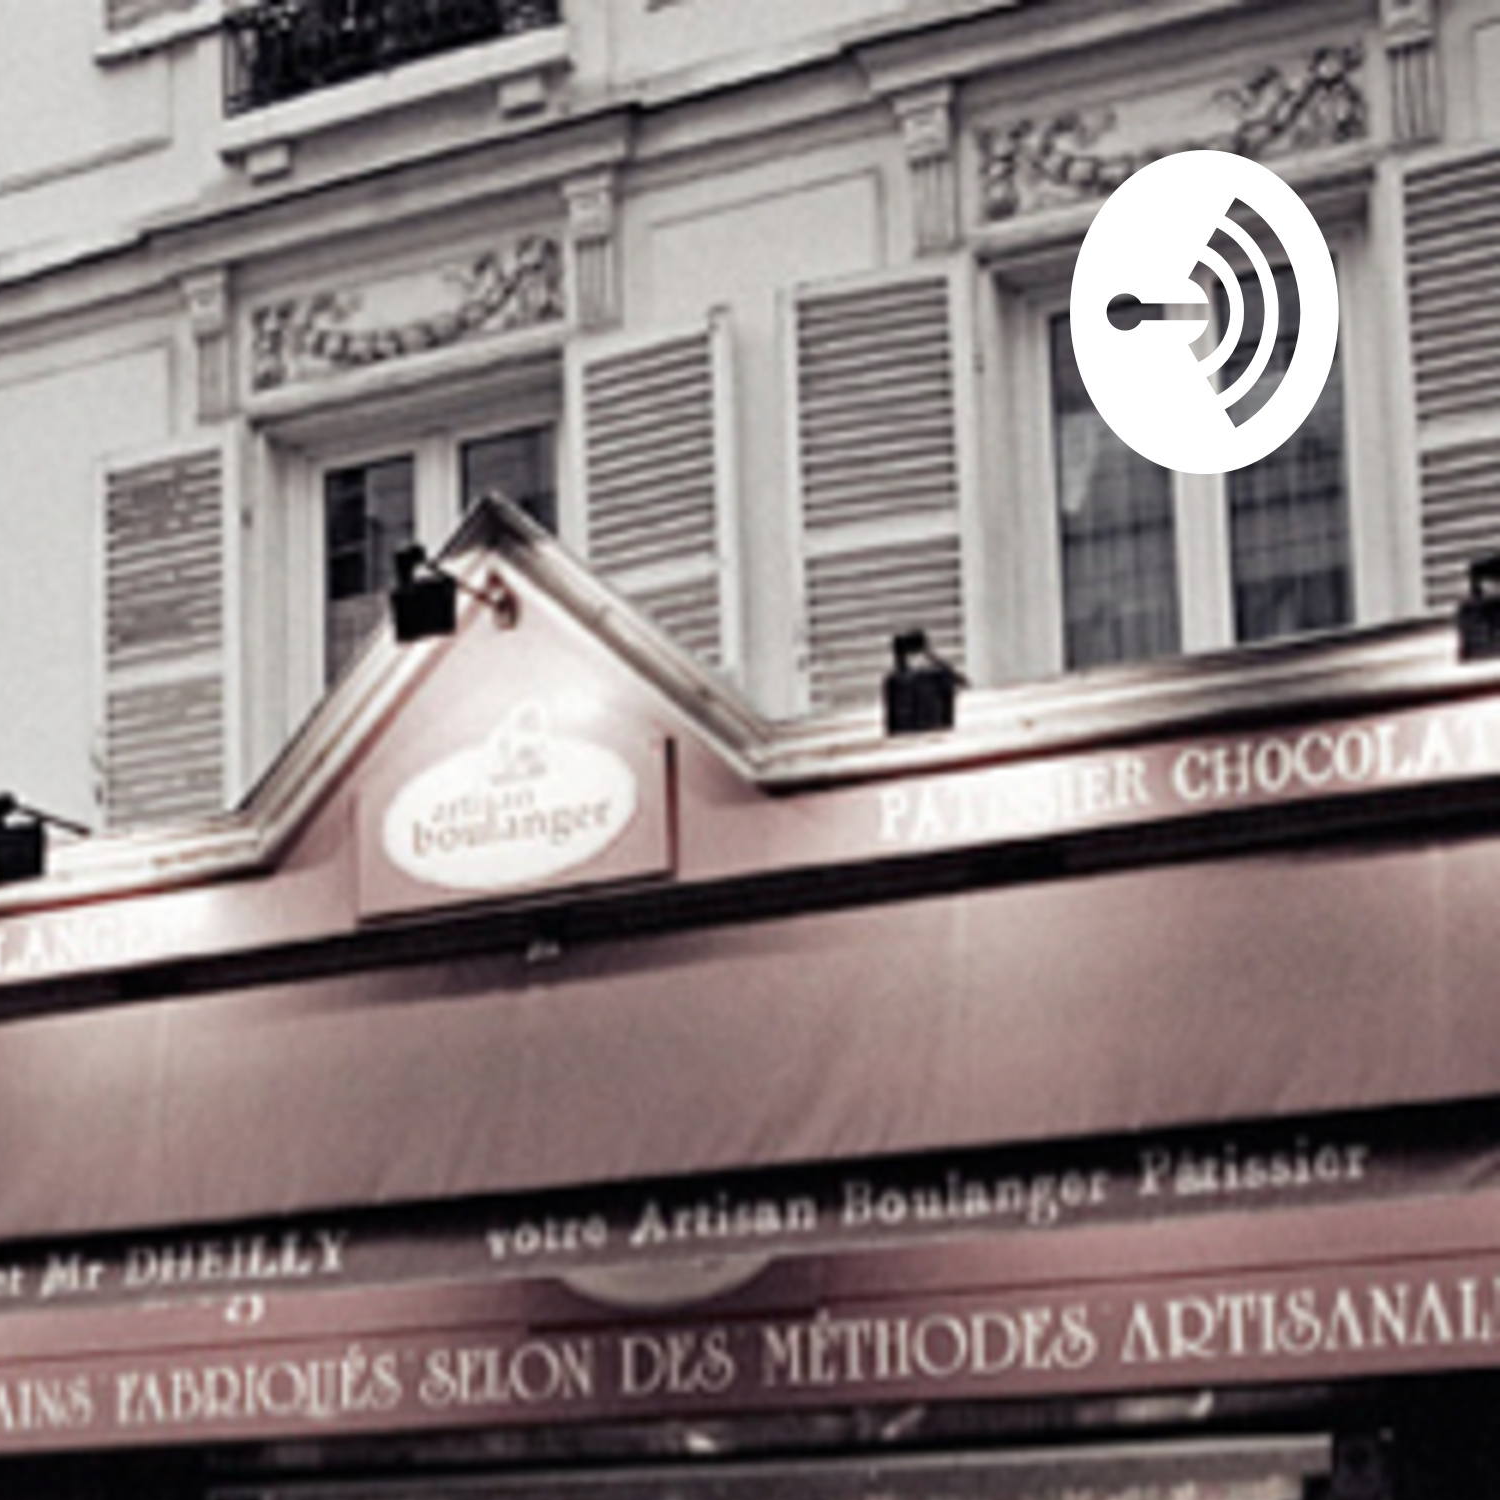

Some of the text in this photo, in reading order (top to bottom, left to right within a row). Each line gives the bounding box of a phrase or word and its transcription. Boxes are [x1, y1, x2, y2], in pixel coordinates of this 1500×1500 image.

[411, 796, 612, 859] boulanger
[877, 756, 1150, 842] PATISIER
[628, 1192, 818, 1248] Artisan
[840, 1166, 1114, 1227] Boulanger
[38, 1250, 106, 1300] Mr
[116, 1343, 402, 1428] FABRIQUÉS
[417, 1338, 598, 1410] SELON
[621, 1328, 736, 1398] DES
[762, 1303, 1098, 1389] MÉTHODES
[1121, 1275, 1499, 1364] ARTISANAL
